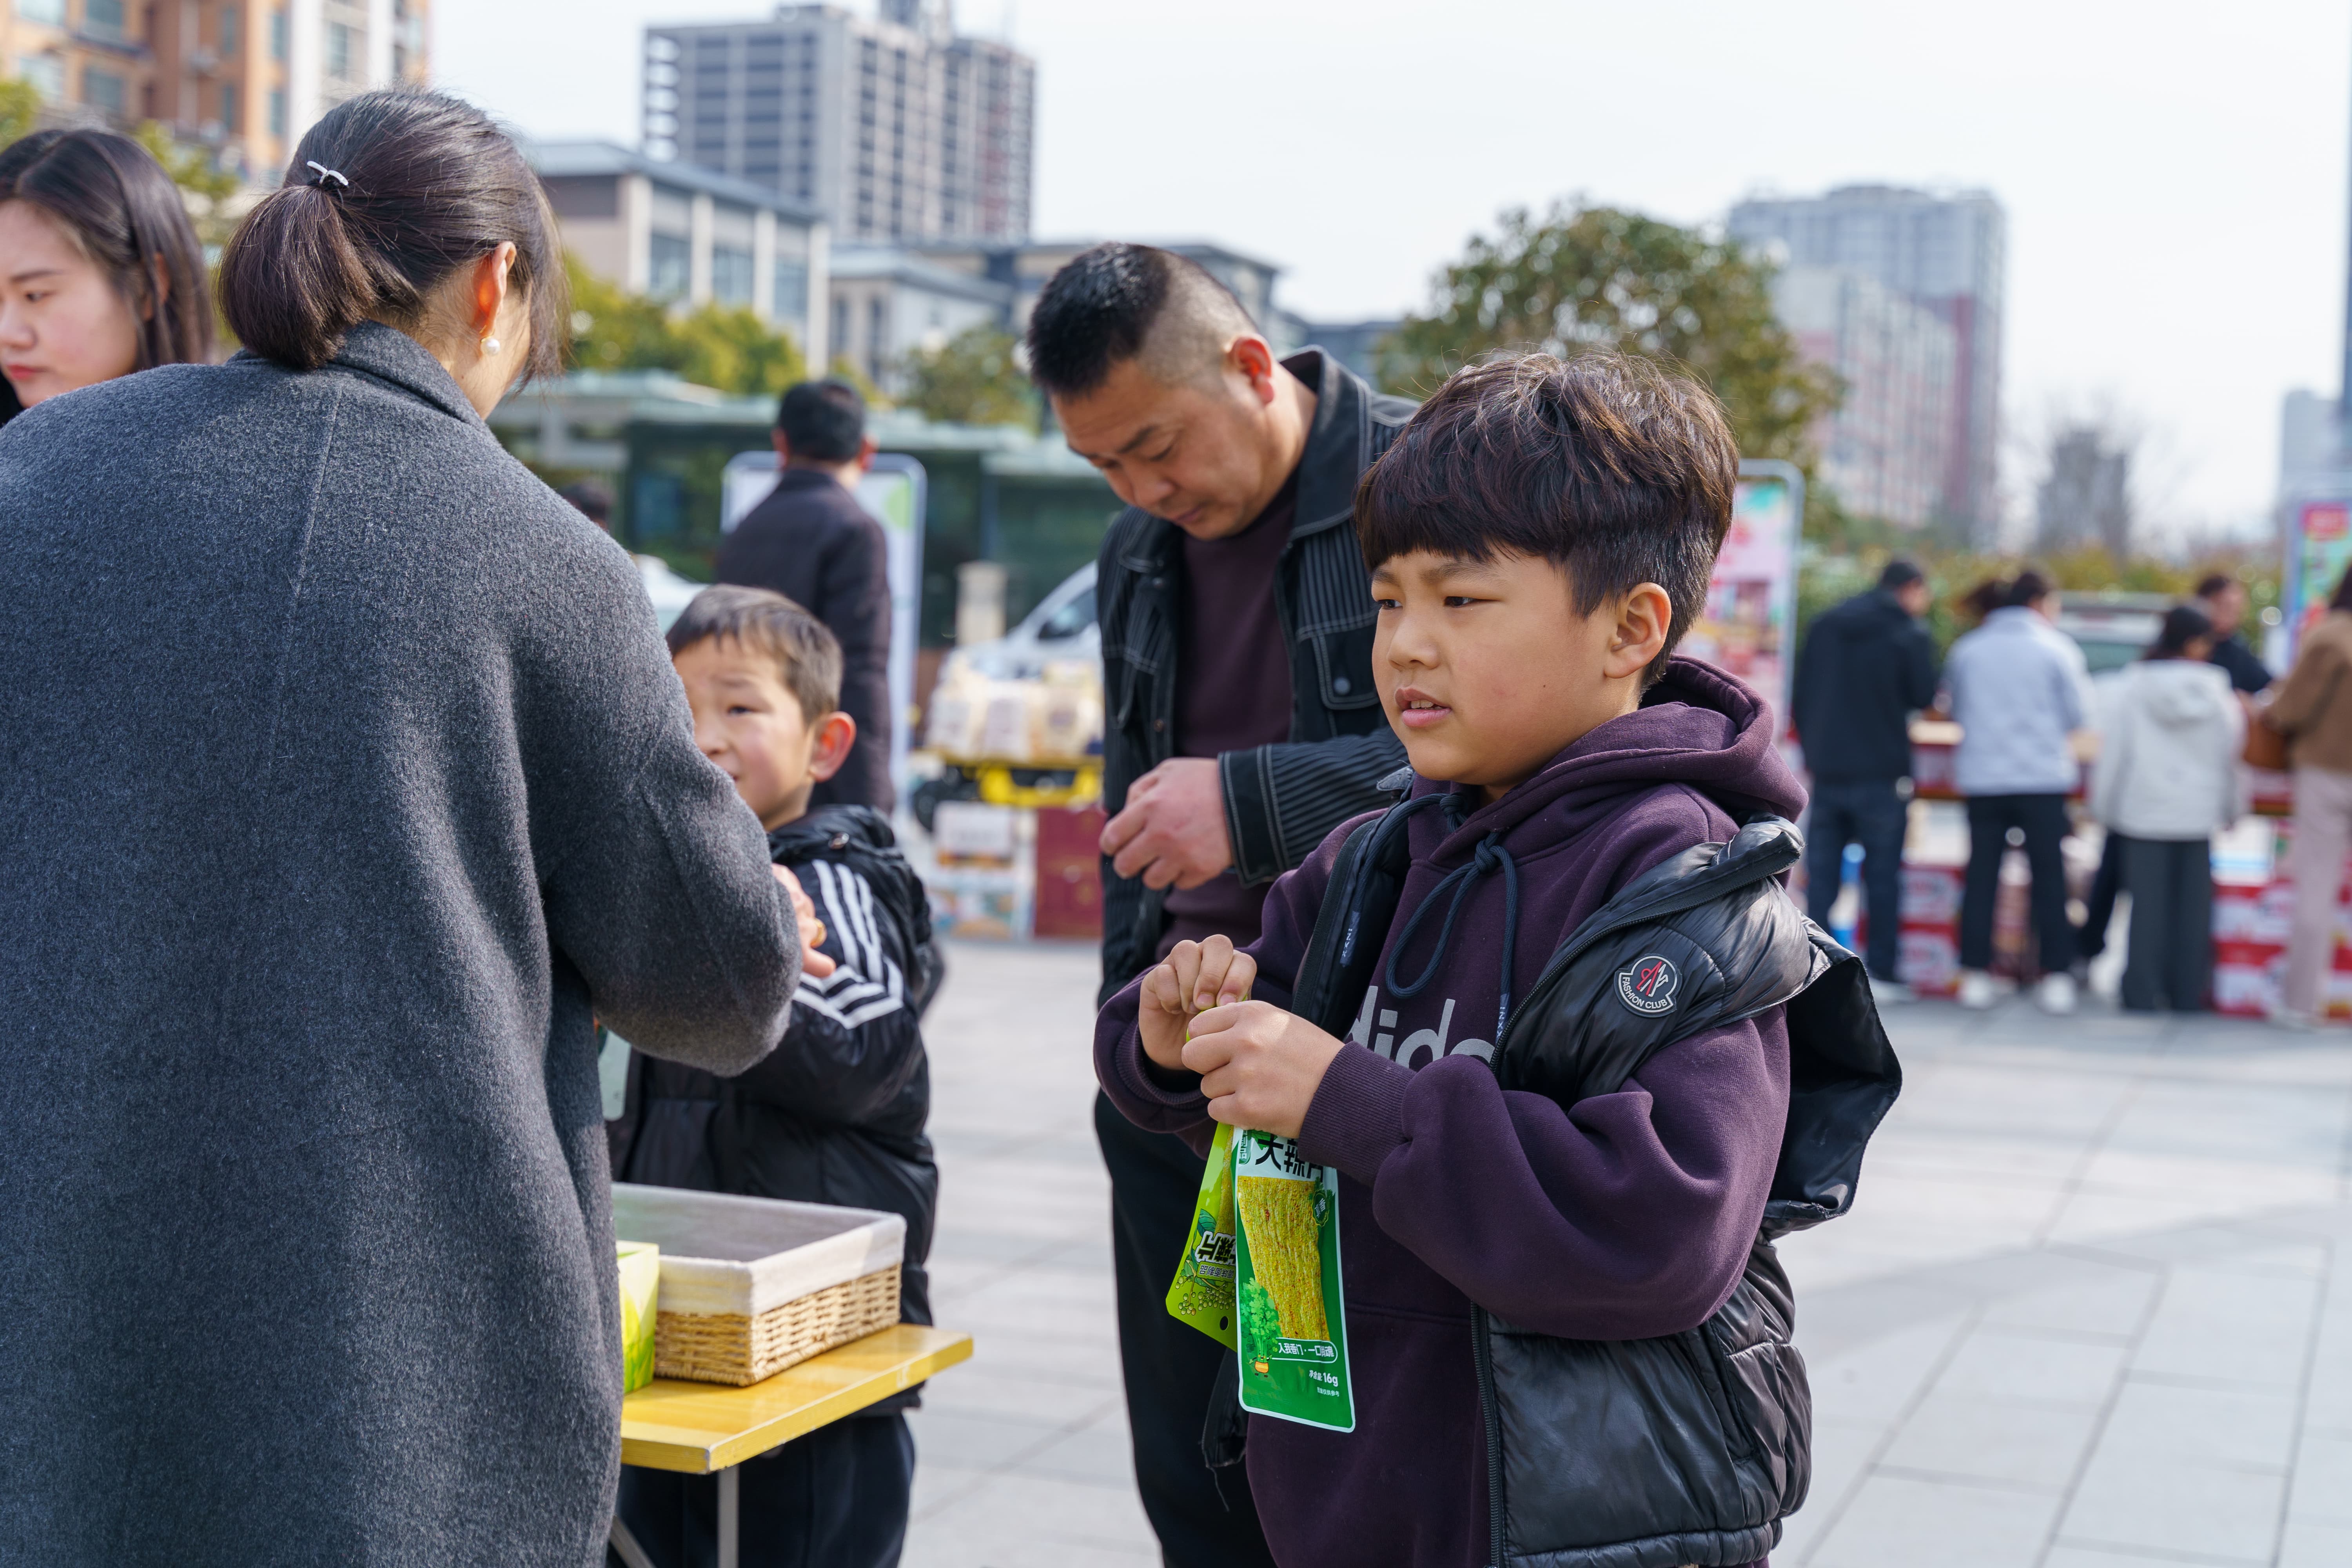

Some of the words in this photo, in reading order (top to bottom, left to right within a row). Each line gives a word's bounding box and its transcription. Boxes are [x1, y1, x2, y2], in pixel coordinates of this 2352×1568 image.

[1622, 977, 1644, 1007] FASHION
[1645, 999, 1668, 1009] CLUB
[1323, 1372, 1338, 1387] 16g
